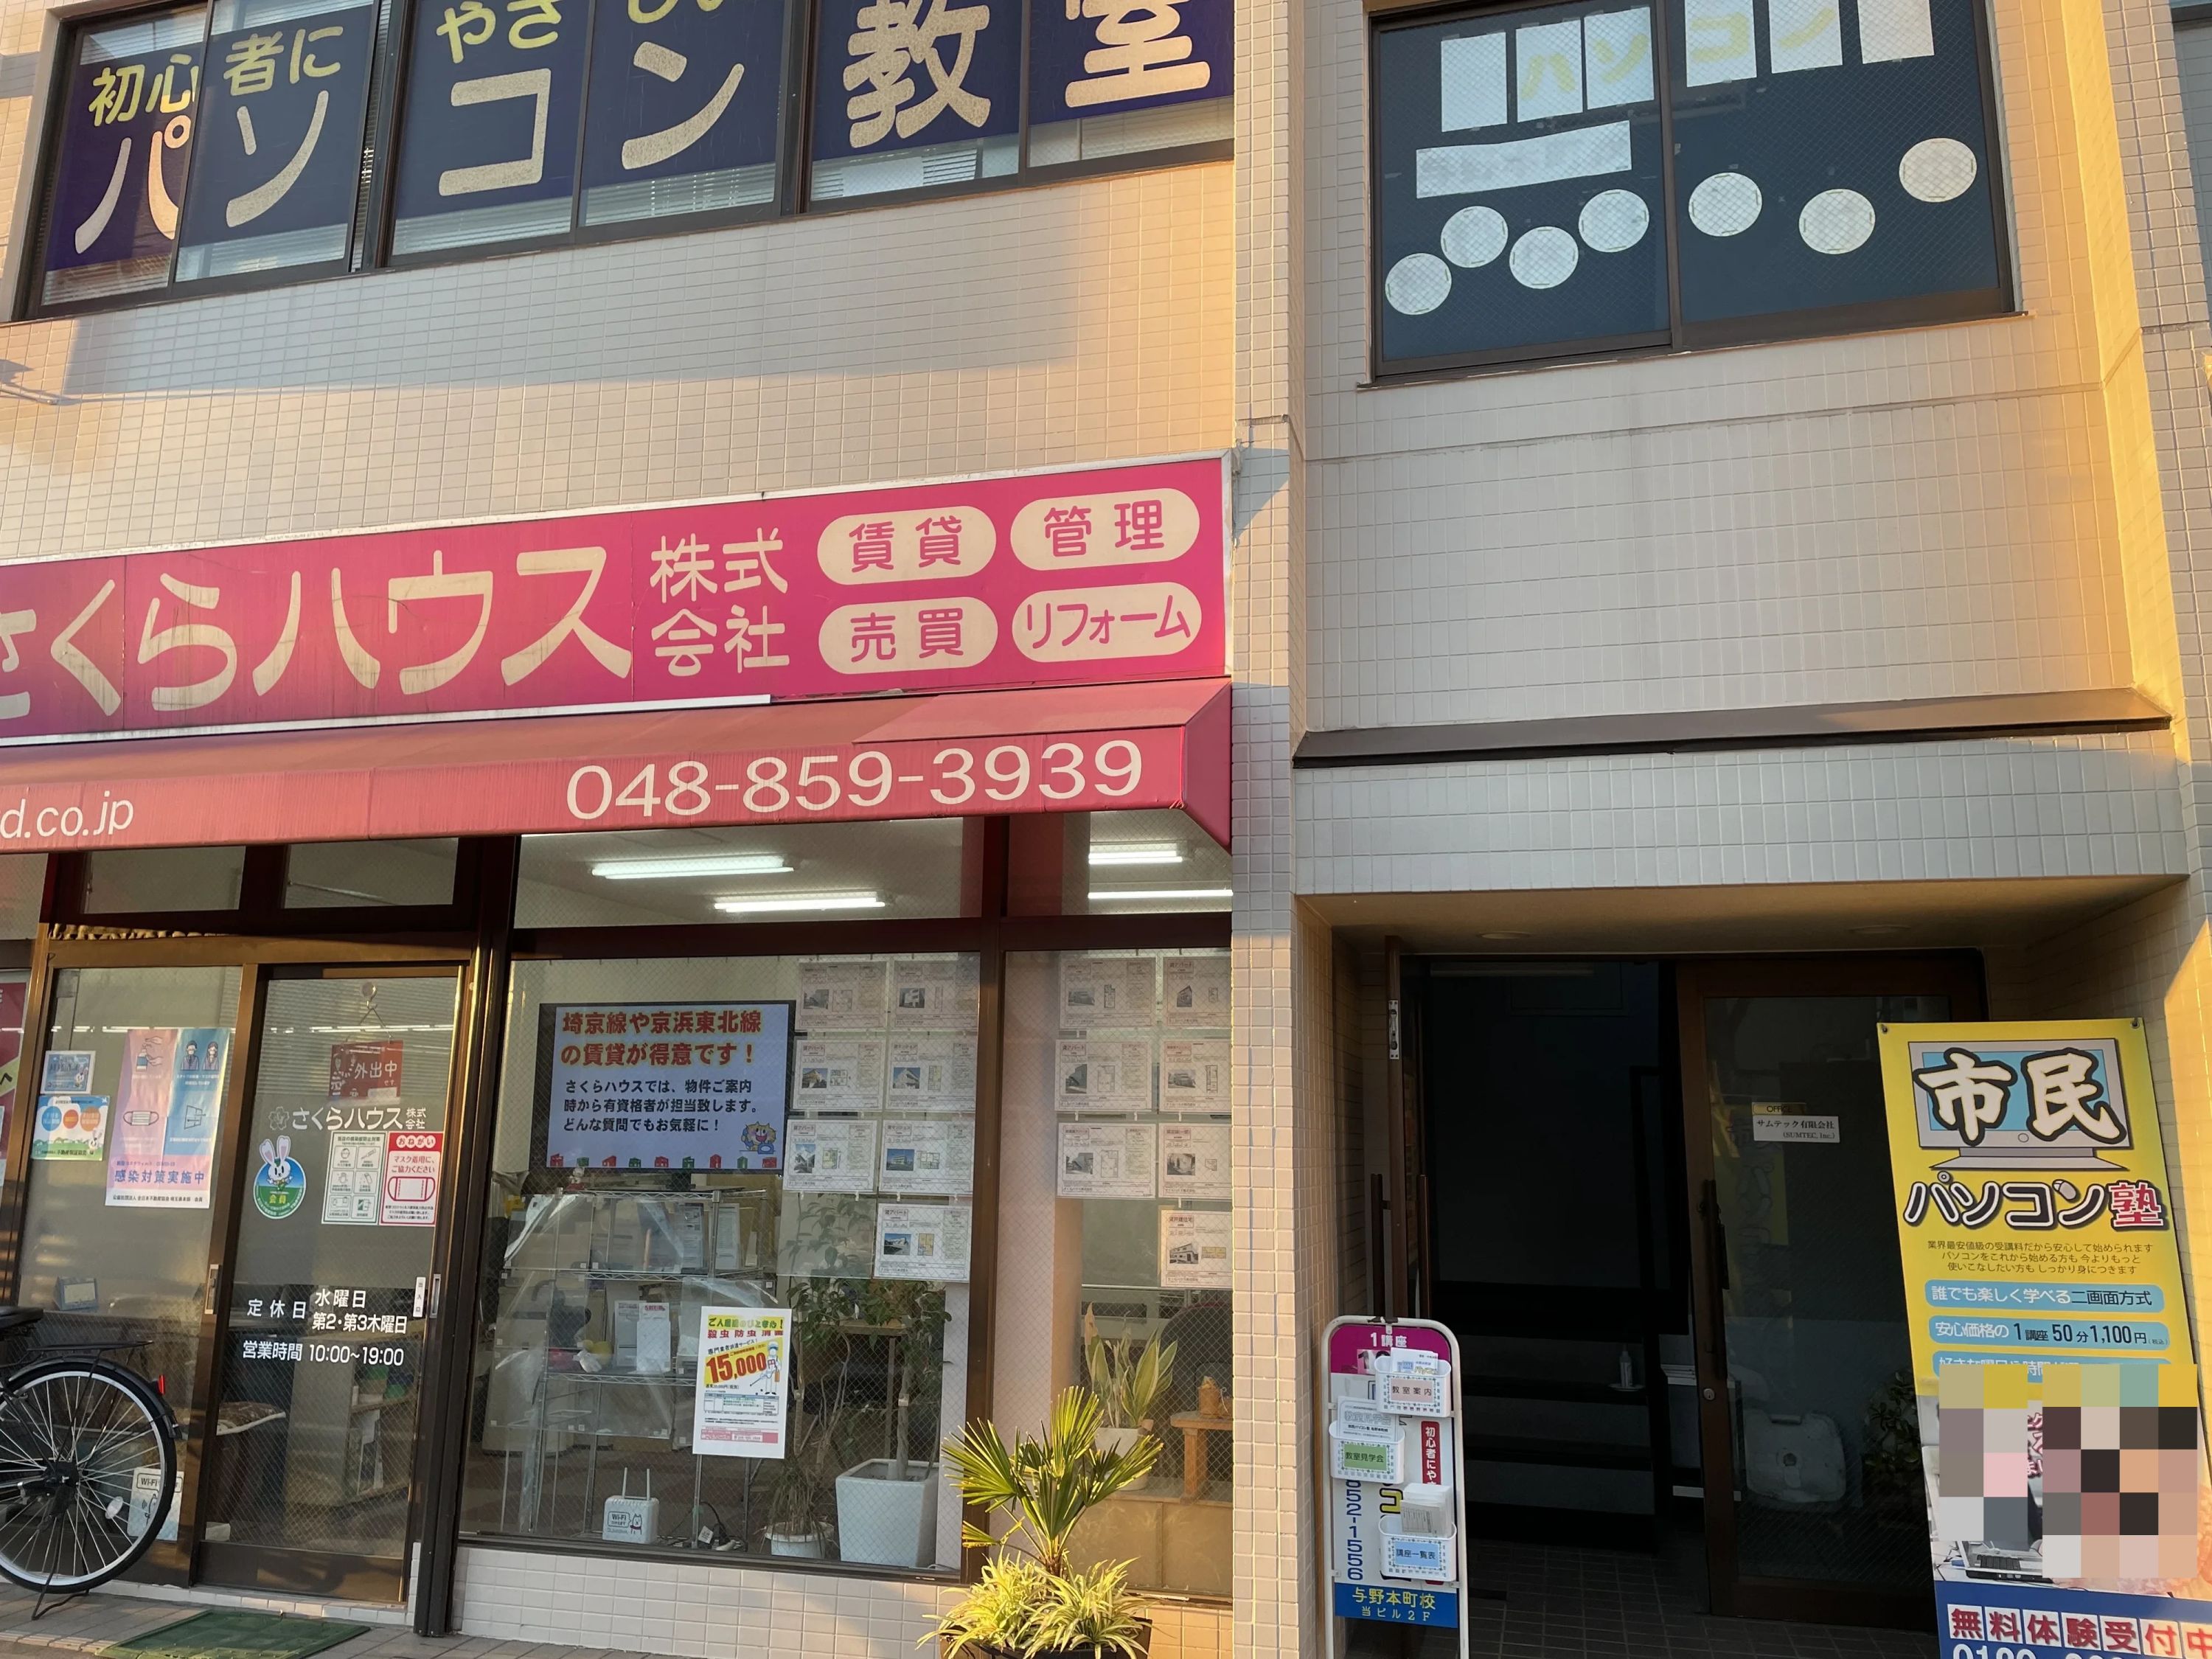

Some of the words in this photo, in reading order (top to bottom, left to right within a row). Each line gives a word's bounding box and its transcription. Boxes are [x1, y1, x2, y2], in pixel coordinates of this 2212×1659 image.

[1043, 498, 1163, 558] 管理
[848, 515, 963, 573] 賃貸
[650, 526, 789, 603] 株式
[1026, 594, 1192, 649] リフォーム
[651, 605, 790, 677] 会社
[850, 606, 964, 663] 売買
[566, 739, 1142, 821] 048-859-3939
[563, 1009, 762, 1034] 埼京線や京浜東北線
[560, 1042, 754, 1066] の賃貸が得意です！
[355, 1060, 397, 1079] 外出中
[566, 1079, 752, 1094] さくらハウスでは、物件ご案内
[1913, 1047, 2128, 1146] 市民
[406, 1107, 427, 1118] 株式
[563, 1099, 757, 1113] 時から有資格者が担当致します。
[292, 1107, 403, 1131] さくらハウス
[406, 1119, 426, 1130] 会社
[563, 1118, 720, 1133] どんな質問でもお気軽に！
[1757, 1119, 1834, 1130] サムテック有限会社
[398, 1137, 434, 1146] おねがい
[391, 1164, 435, 1174] ご協力ください
[394, 1155, 435, 1164] マスク着用に、
[114, 1169, 205, 1185] 感染対策実施中
[1903, 1171, 2170, 1231] パソコン塾
[2081, 1253, 2141, 1264] 今よりもっと
[246, 1298, 307, 1320] 定休日
[315, 1288, 367, 1309] 水曜日
[312, 1312, 407, 1335] 第2・第3木曜日
[1935, 1322, 2009, 1339] 安心価格の
[1370, 1332, 1408, 1348] 1講座
[243, 1340, 303, 1362] 営業時間
[706, 1352, 776, 1383] 15,000円
[1392, 1385, 1433, 1397] 教室案内
[1346, 1451, 1384, 1463] 教室見学会
[1425, 1426, 1437, 1484] 初心者にや
[141, 1477, 158, 1486] Wi-Fi
[1396, 1548, 1437, 1560] 講座一覧表
[1352, 1586, 1436, 1610] 与野本町校
[1951, 1607, 2212, 1659] 無料体験受付中
